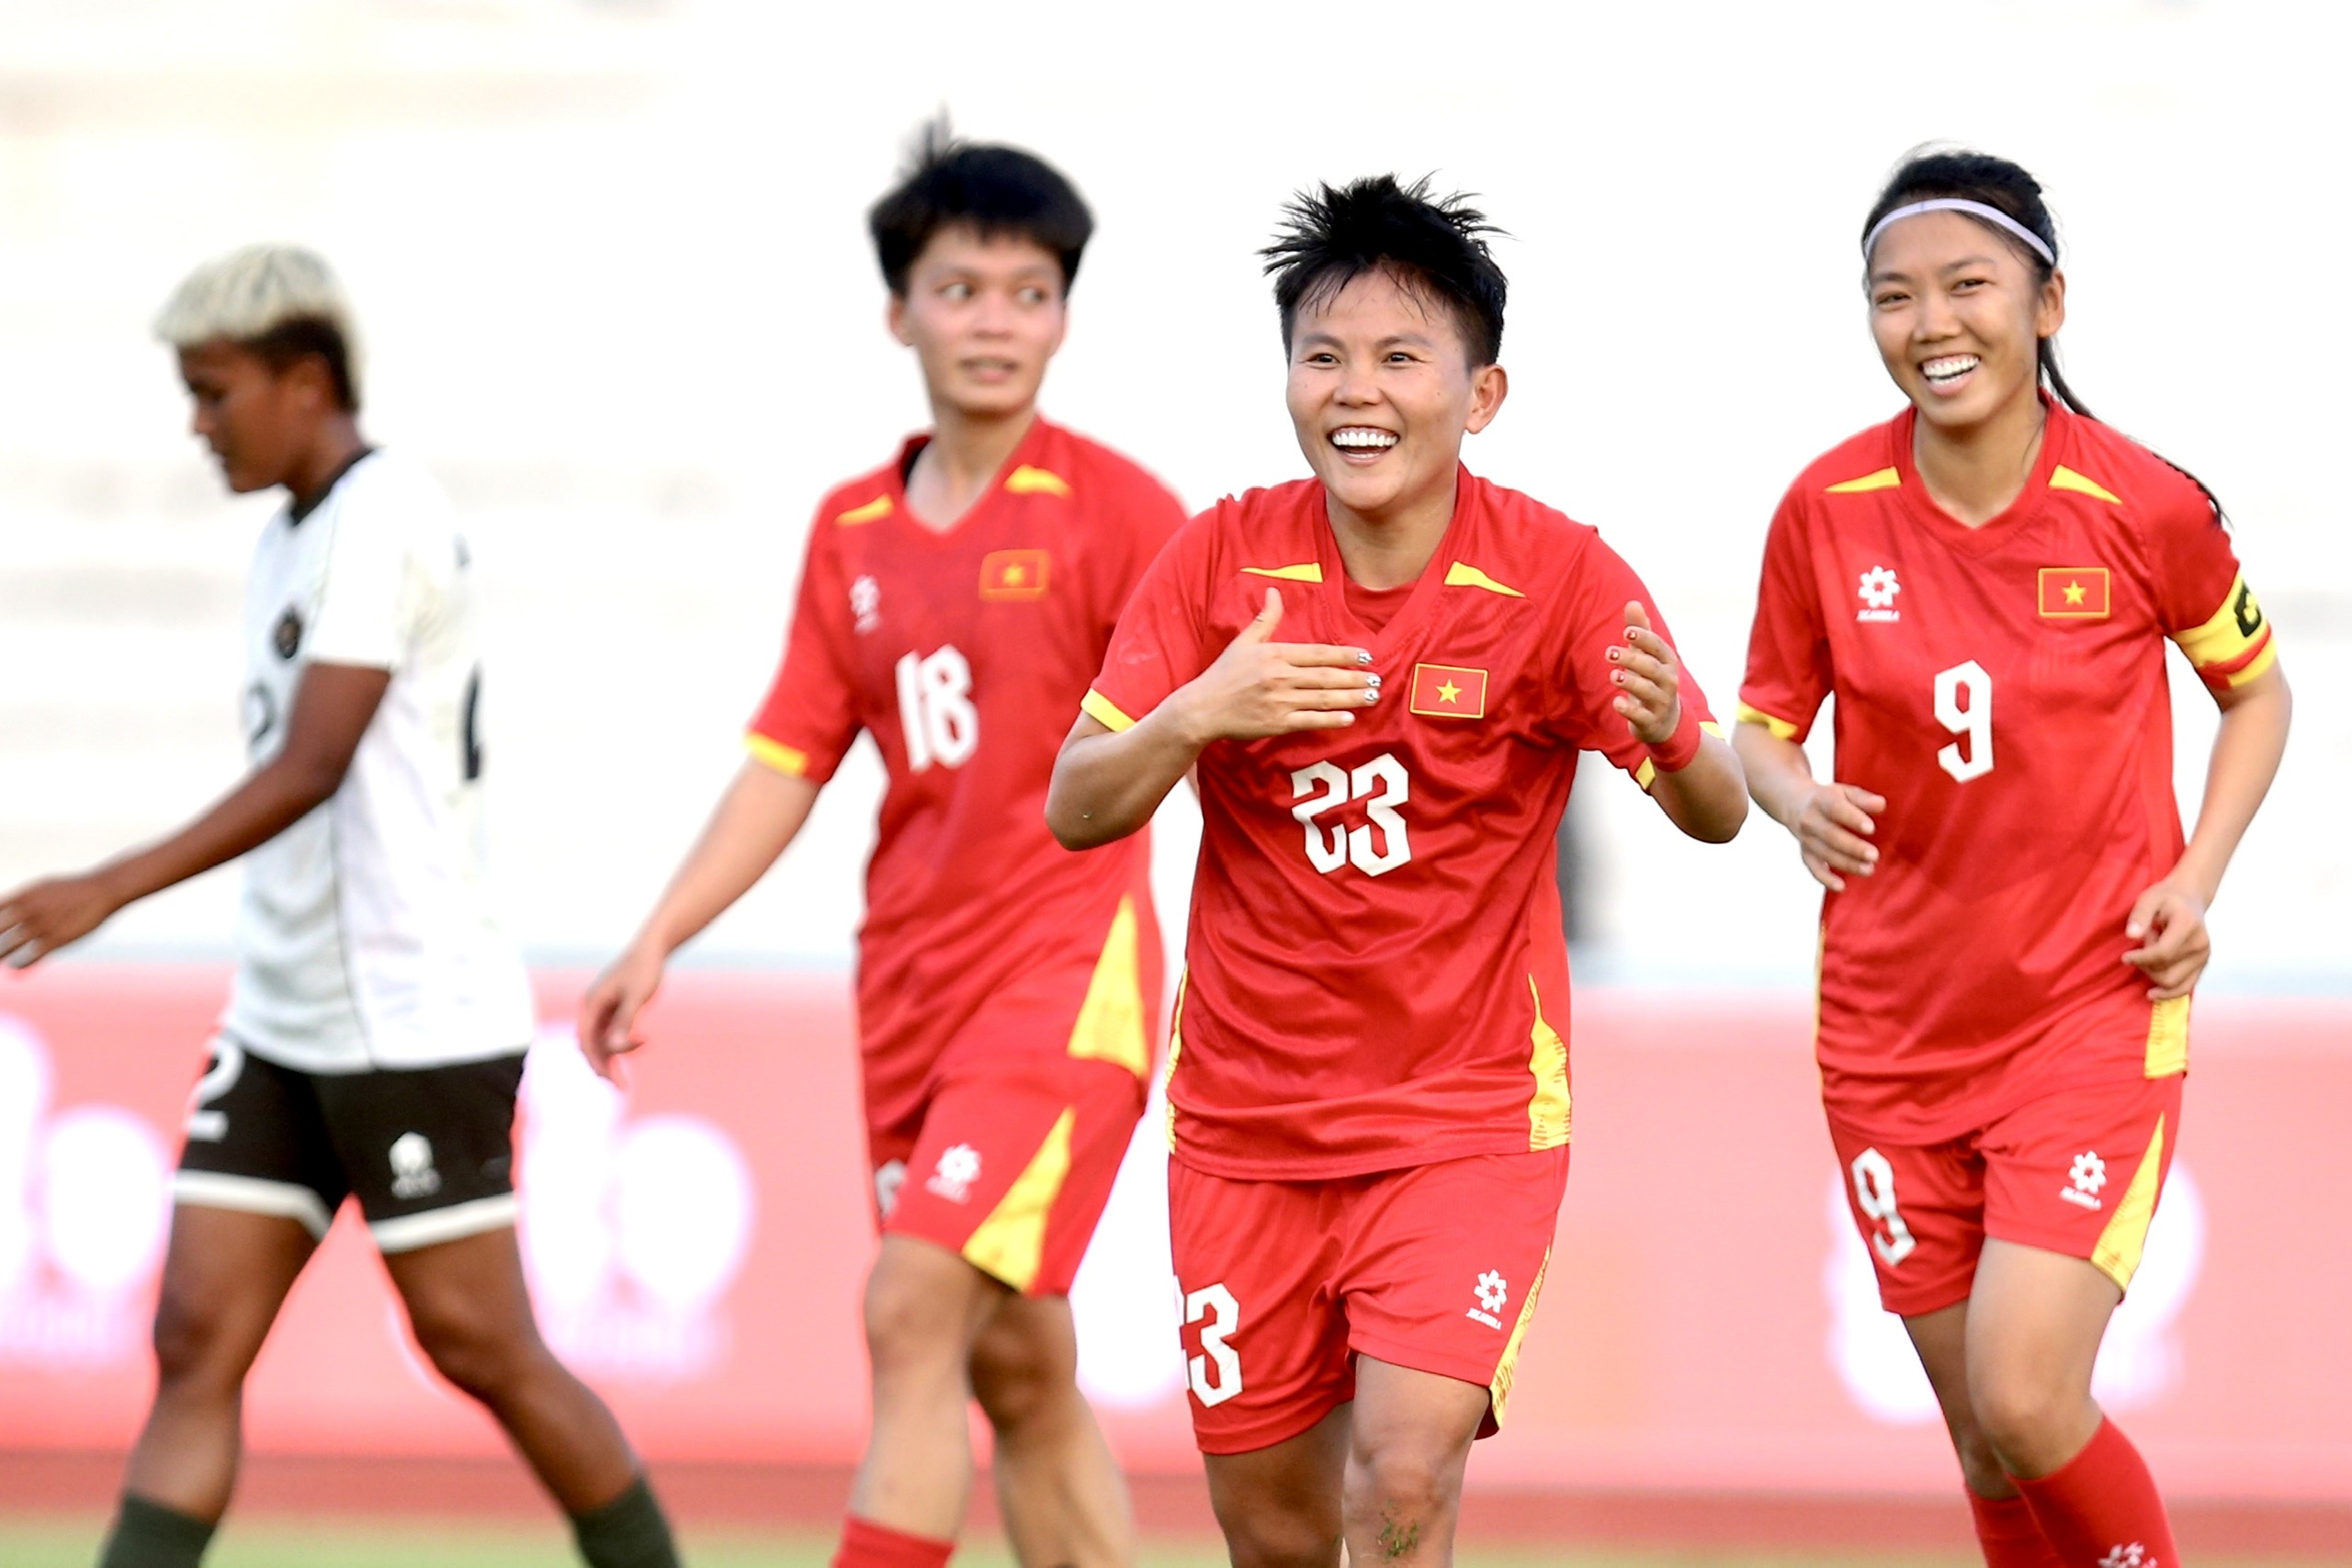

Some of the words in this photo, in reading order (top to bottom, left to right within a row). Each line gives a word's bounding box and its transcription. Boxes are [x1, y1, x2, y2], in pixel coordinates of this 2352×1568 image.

[896, 644, 978, 772] 18
[1933, 659, 1994, 783] 9
[1291, 752, 1411, 876] 23
[1851, 1147, 1917, 1266] 9
[1174, 1275, 1243, 1408] 3
